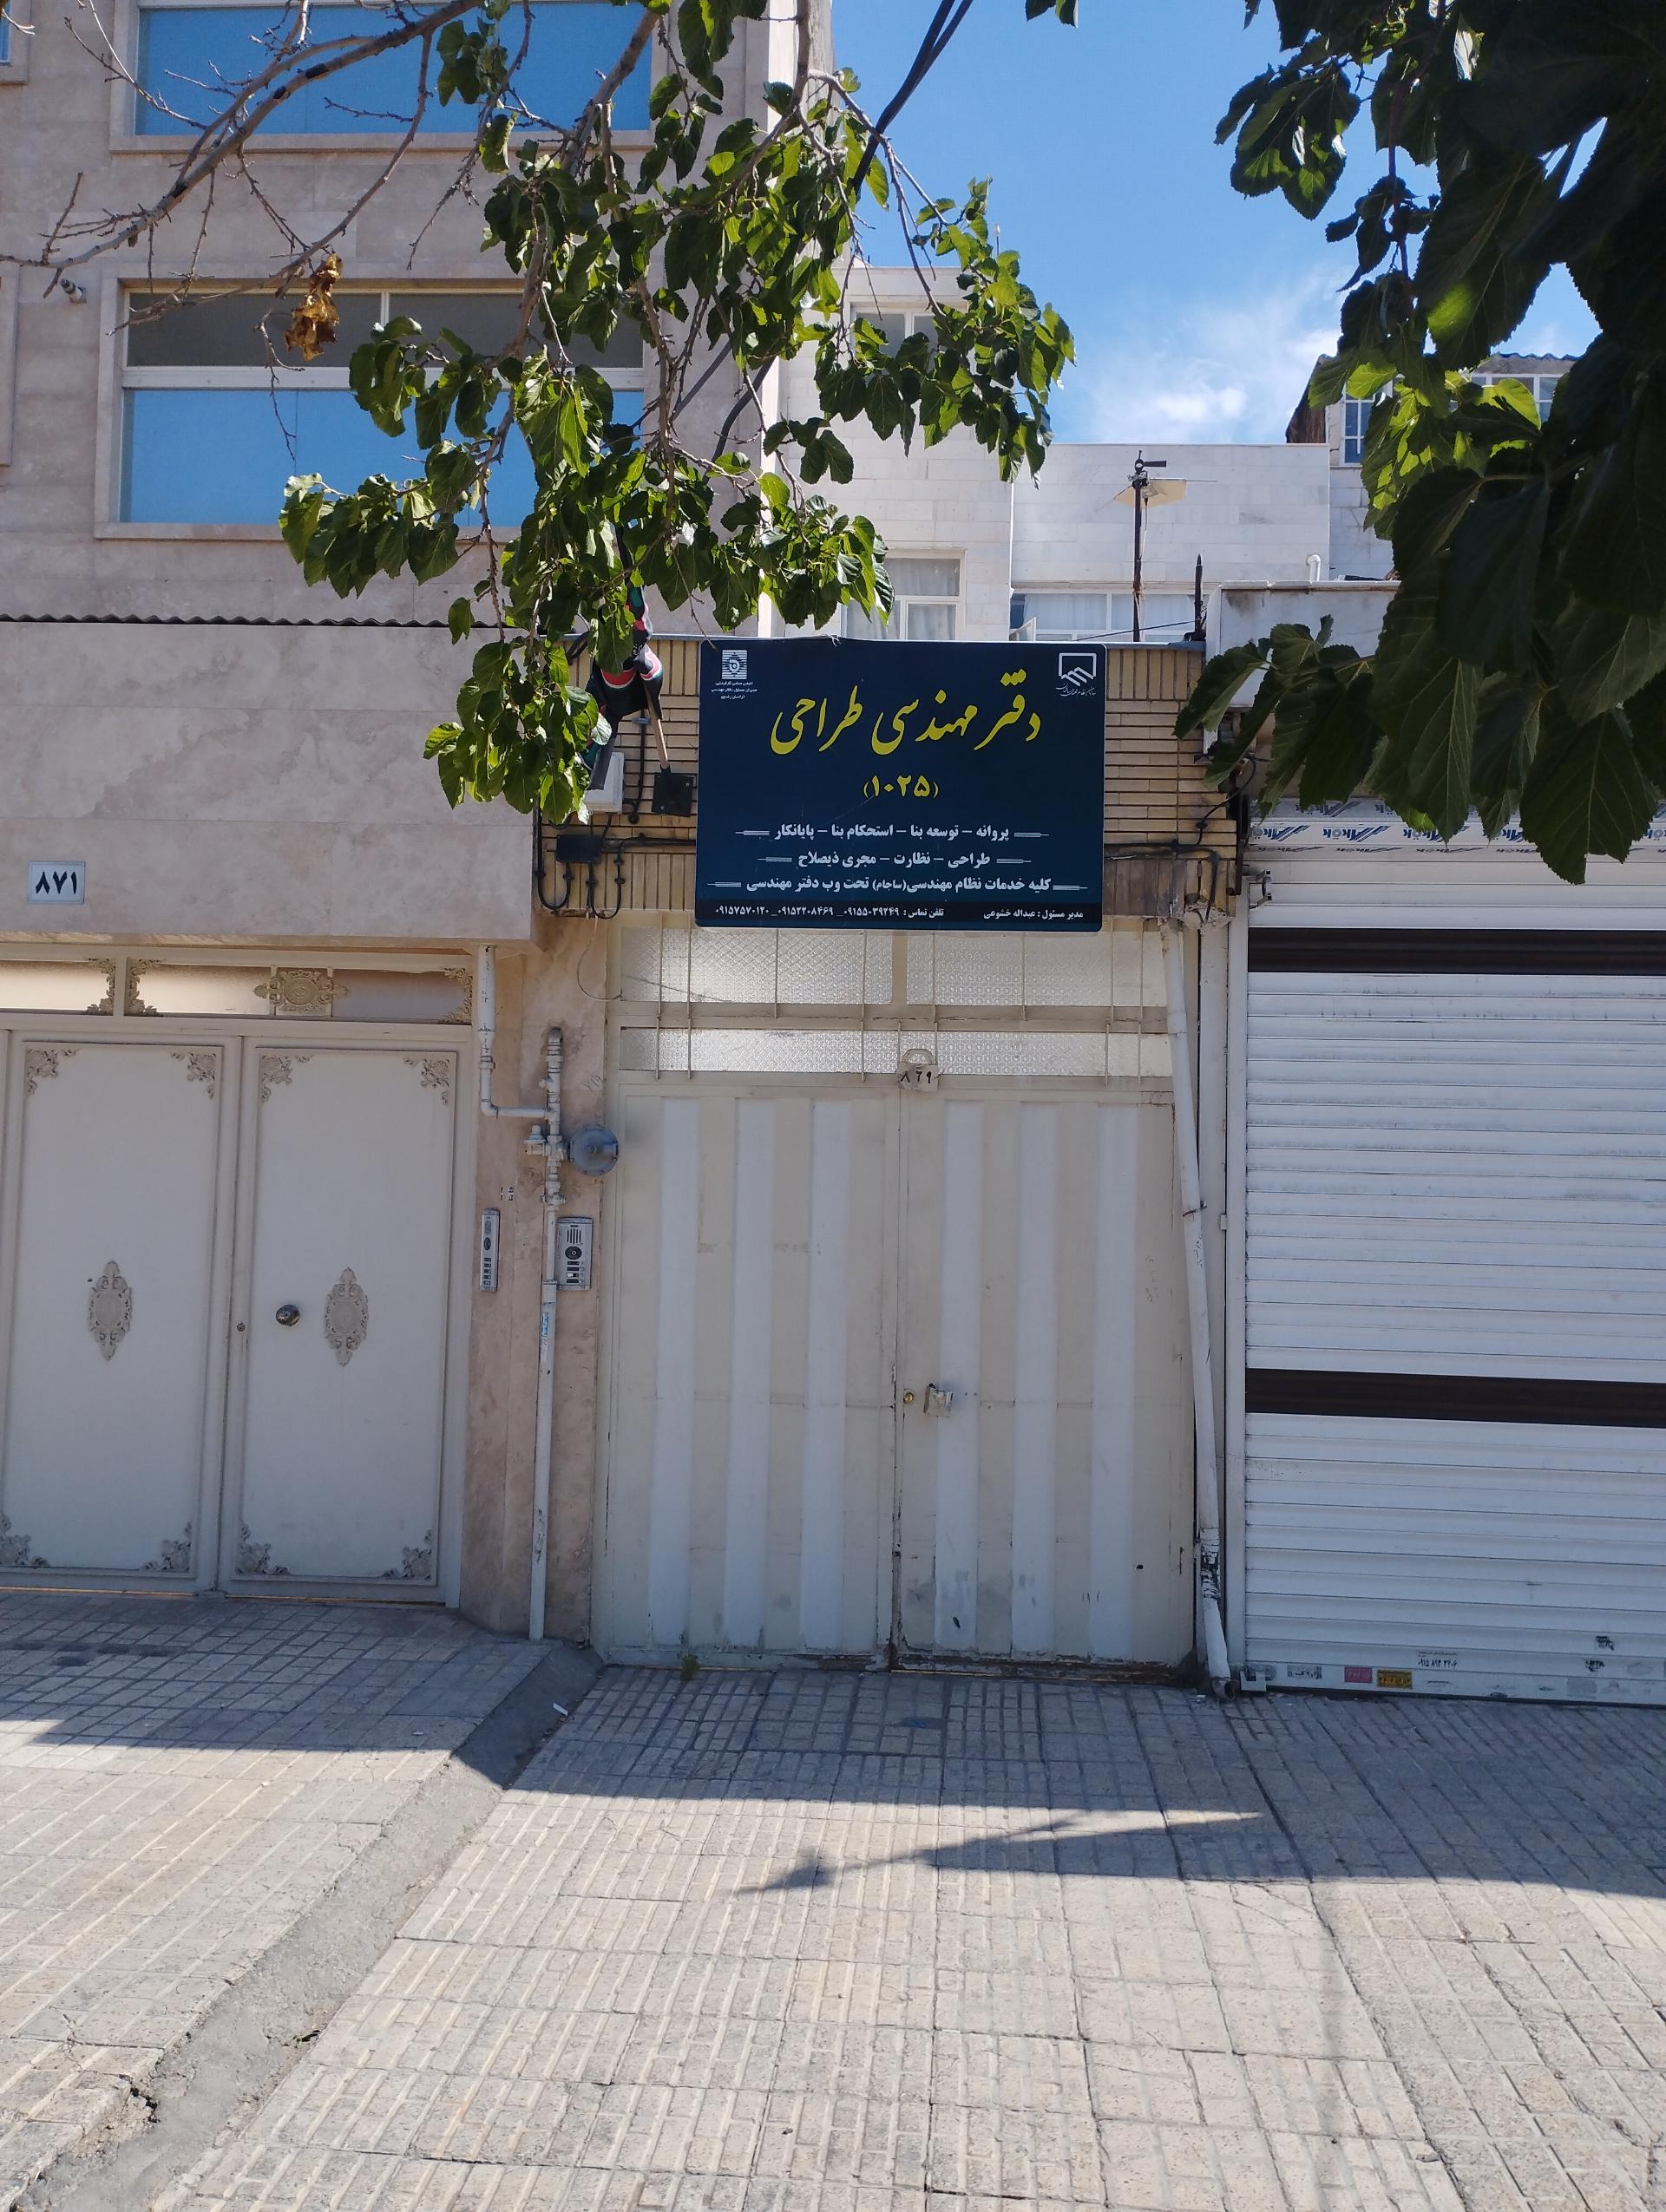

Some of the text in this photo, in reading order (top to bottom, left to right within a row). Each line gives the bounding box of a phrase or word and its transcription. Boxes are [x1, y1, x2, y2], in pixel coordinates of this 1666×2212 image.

[771, 669, 1040, 755] دفتر مهندسی طراحی
[775, 824, 814, 840] پایانکار
[832, 824, 843, 839] بنا
[847, 824, 893, 840] استحکام
[911, 825, 922, 839] بنا
[927, 825, 958, 841] توسعه
[976, 825, 1008, 841] پروانه
[798, 851, 839, 867] ذیصلاح
[843, 855, 876, 867] مجری
[894, 852, 930, 867] نظارت
[948, 853, 990, 868] طراحی
[36, 872, 76, 893] ۸۷۱
[747, 878, 791, 891] مهندسی
[795, 875, 819, 892] دفتر
[843, 877, 869, 888] تحت
[955, 877, 981, 893] نظام
[985, 878, 1025, 889] خدمات
[1029, 878, 1051, 893] کلیه
[929, 908, 944, 919] تلفن
[1067, 911, 1084, 920] مدیر
